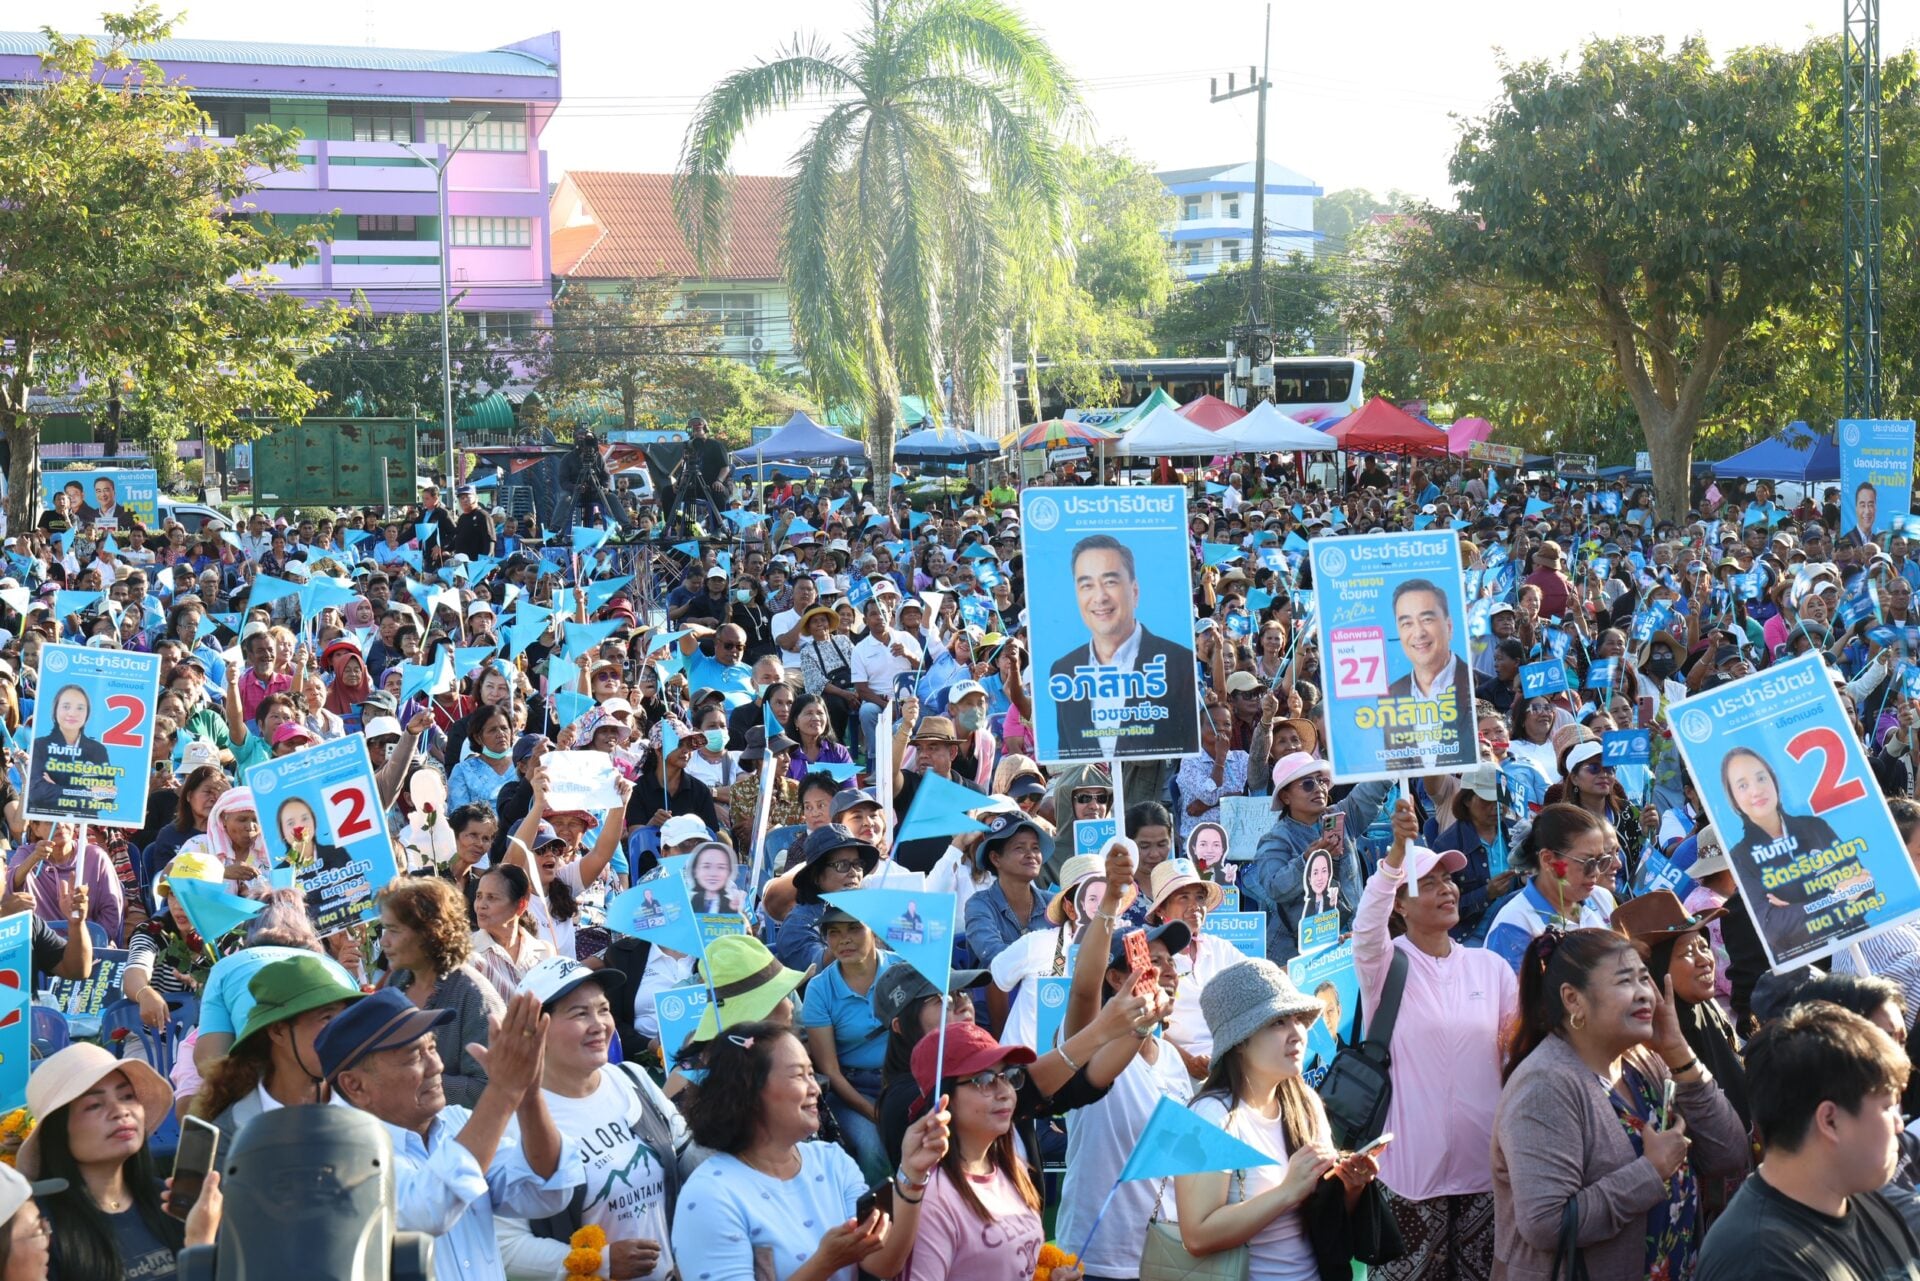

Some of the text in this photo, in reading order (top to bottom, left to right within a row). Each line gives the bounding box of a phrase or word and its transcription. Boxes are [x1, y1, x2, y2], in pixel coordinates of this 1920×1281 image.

[125, 485, 153, 500] ไทย
[1064, 494, 1175, 515] ประชาธิปัตย์
[1135, 517, 1167, 525] PARTY
[1350, 539, 1448, 561] ประชาธิปัตย์
[1745, 582, 1758, 597] 5
[1640, 625, 1651, 640] 5
[72, 653, 152, 672] ประชาธิปัตย์
[1339, 656, 1380, 686] 27
[1049, 654, 1168, 701] อภิสิทธิ์
[1526, 672, 1545, 689] 27
[1710, 664, 1816, 719] ประชาธิปัตย์
[1091, 701, 1169, 723] เวชชาชีวะ
[1355, 687, 1458, 731] อภิสิทธิ์
[102, 693, 146, 749] 2
[47, 742, 82, 757] ทับทิม
[277, 741, 358, 776] ประชาธิปัตย์
[1608, 740, 1629, 757] 27
[1785, 726, 1868, 816] 2
[70, 775, 115, 792] เหตุทอง
[58, 798, 77, 808] เขต
[80, 799, 86, 808] 1
[88, 797, 119, 814] พัทลุง
[330, 787, 372, 839] 2
[1515, 793, 1525, 818] 5
[1751, 836, 1799, 864] ทับทิม
[321, 875, 367, 900] เหตุทอง
[1803, 861, 1862, 896] เหตุทอง
[317, 911, 338, 925] เขต
[340, 907, 347, 919] 1
[1805, 891, 1887, 935] เขต 1 พัทลุง
[1201, 918, 1259, 931] ชาธิปัตย์
[1303, 928, 1313, 944] 2
[608, 1181, 663, 1212] MOUNTAIN
